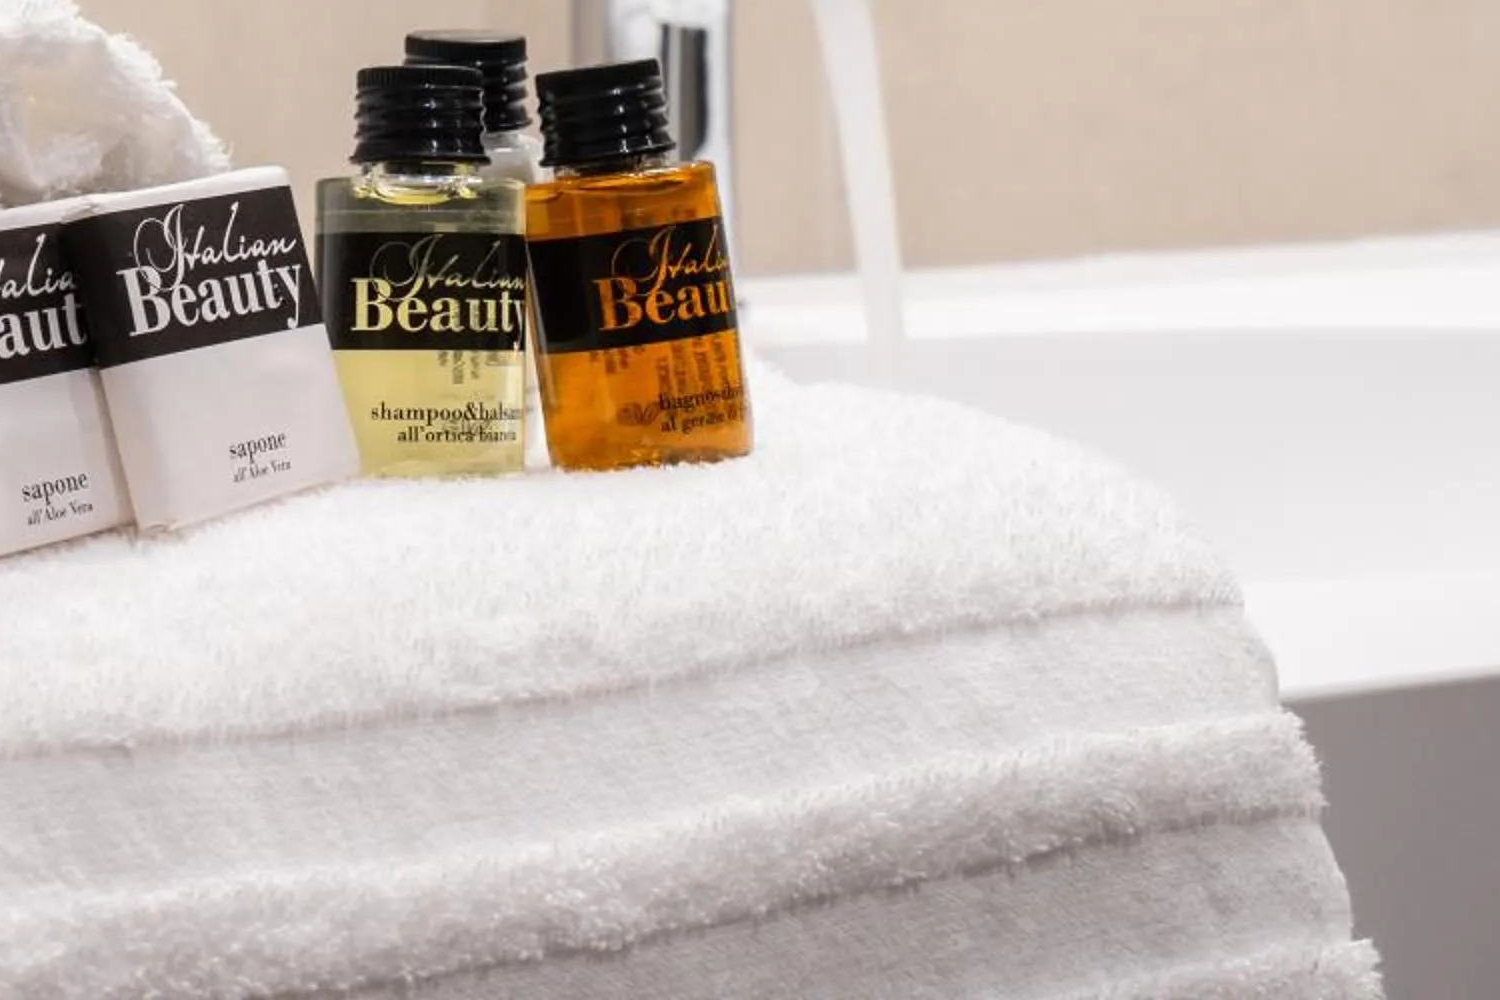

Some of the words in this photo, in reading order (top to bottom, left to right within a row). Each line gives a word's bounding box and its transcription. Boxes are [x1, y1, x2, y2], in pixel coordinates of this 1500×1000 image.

[133, 200, 297, 292] Italian
[115, 258, 302, 337] Beauty
[591, 279, 731, 332] Beau
[229, 432, 286, 464] sapone
[21, 472, 88, 506] sapone
[69, 500, 94, 515] Vera
